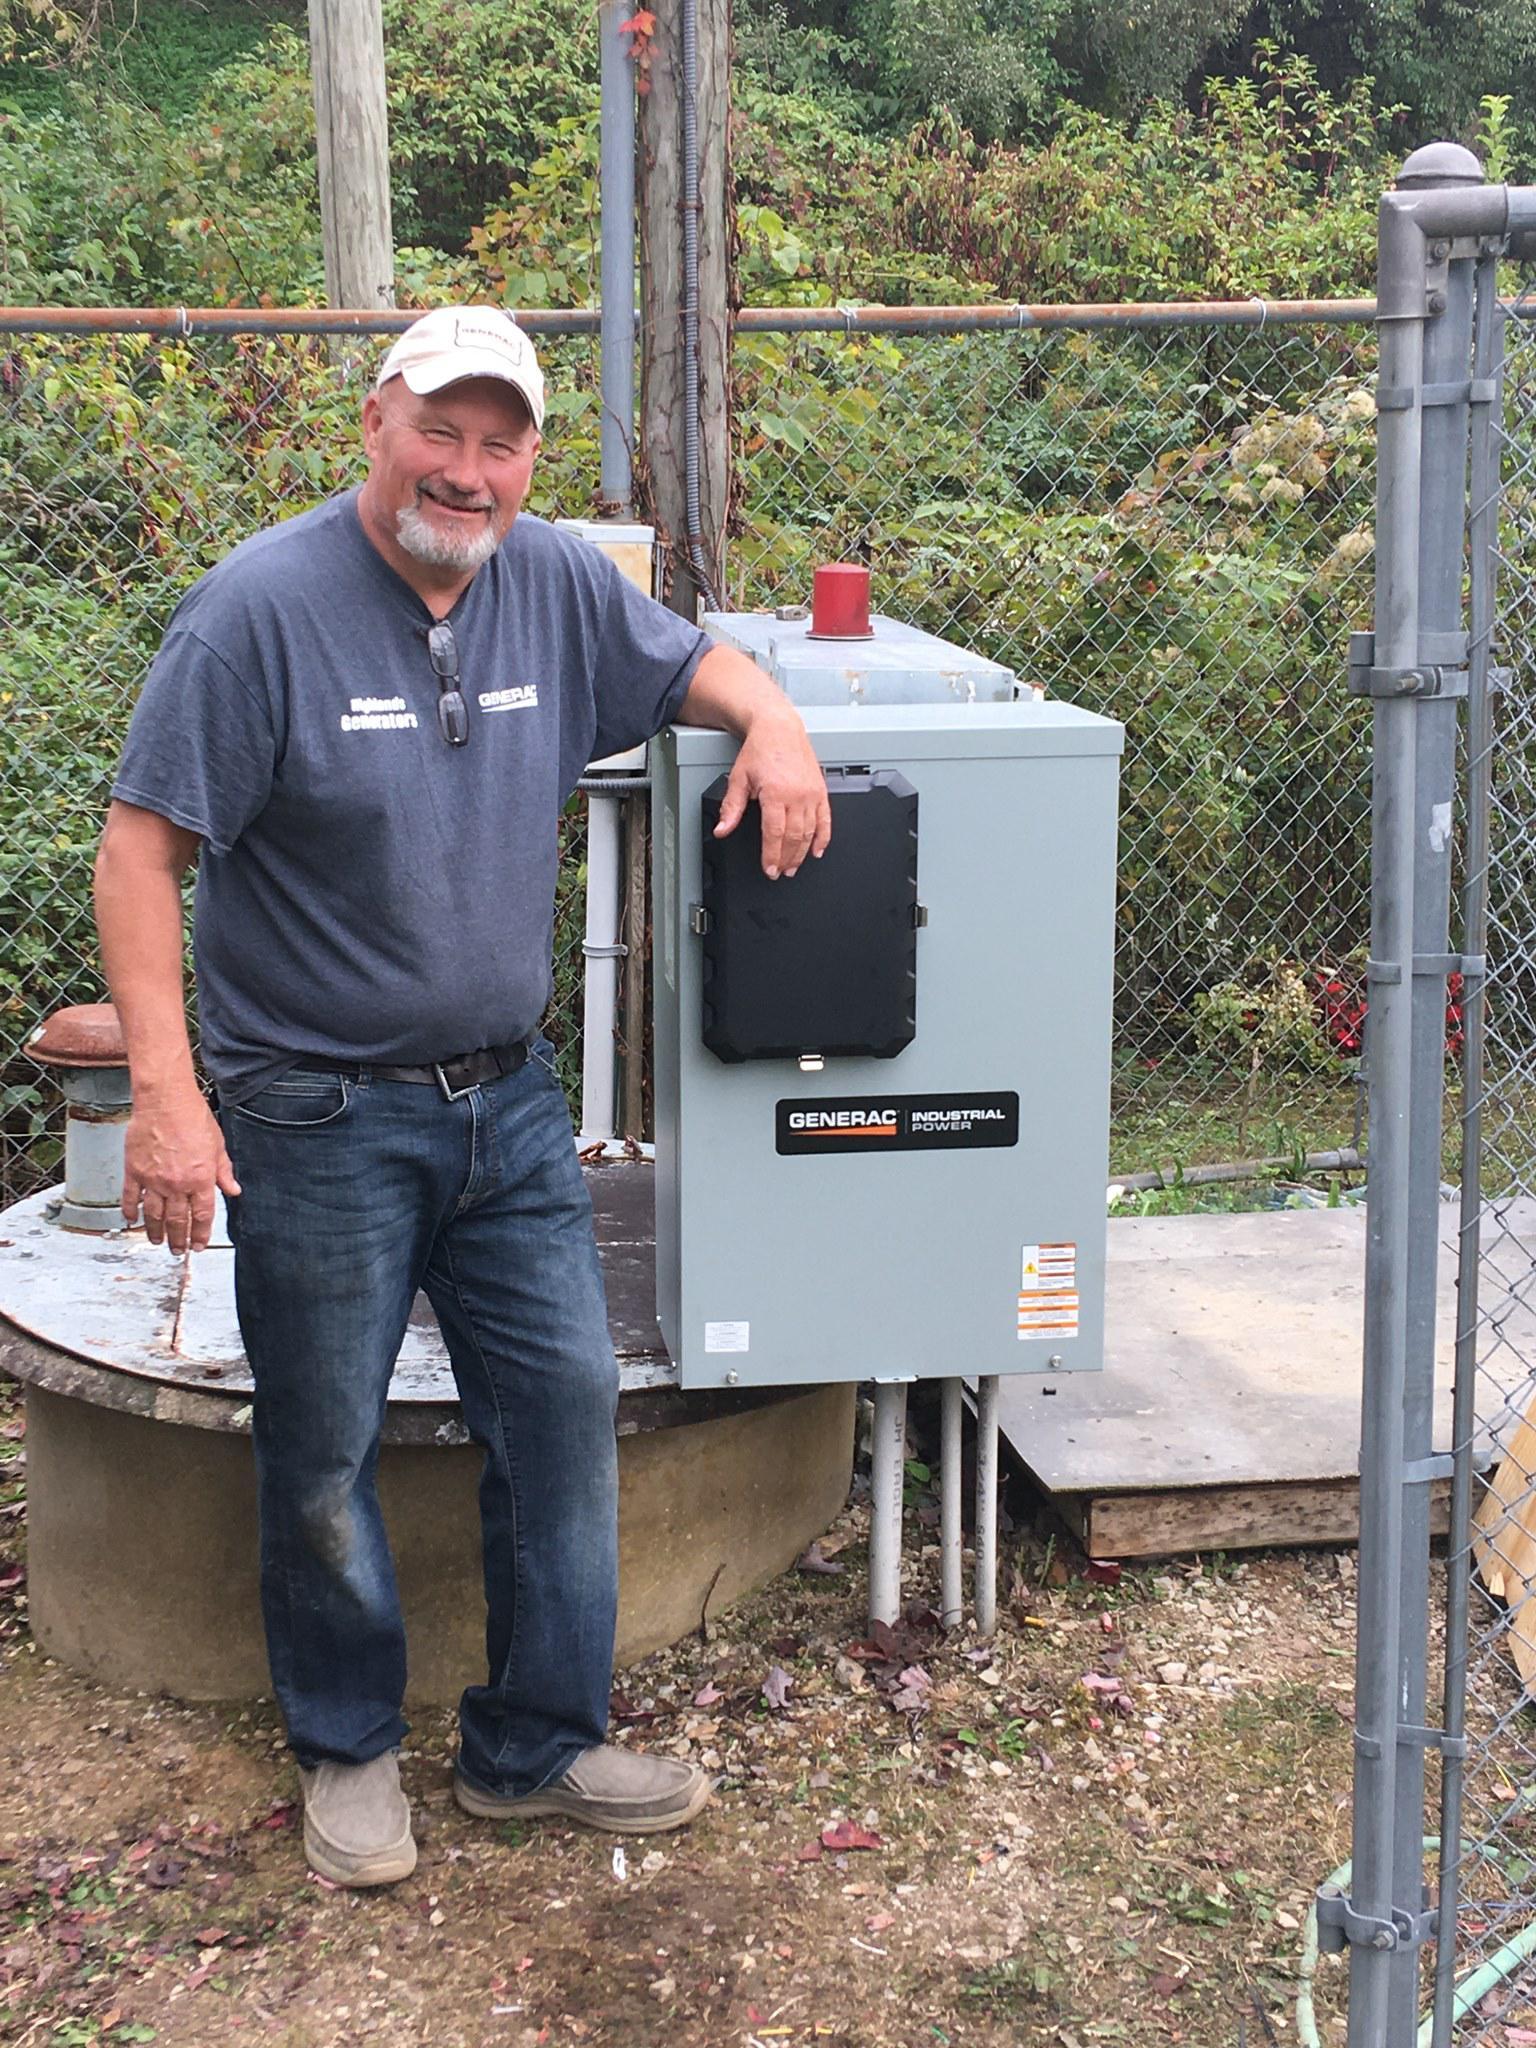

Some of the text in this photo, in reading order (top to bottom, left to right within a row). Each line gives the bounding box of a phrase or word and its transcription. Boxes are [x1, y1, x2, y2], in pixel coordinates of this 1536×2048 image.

[479, 684, 537, 707] GENERAC
[341, 713, 418, 732] Generators
[789, 1109, 897, 1128] GENERAC
[911, 1109, 1006, 1122] INDUSTRIAL
[912, 1121, 972, 1132] POWER
